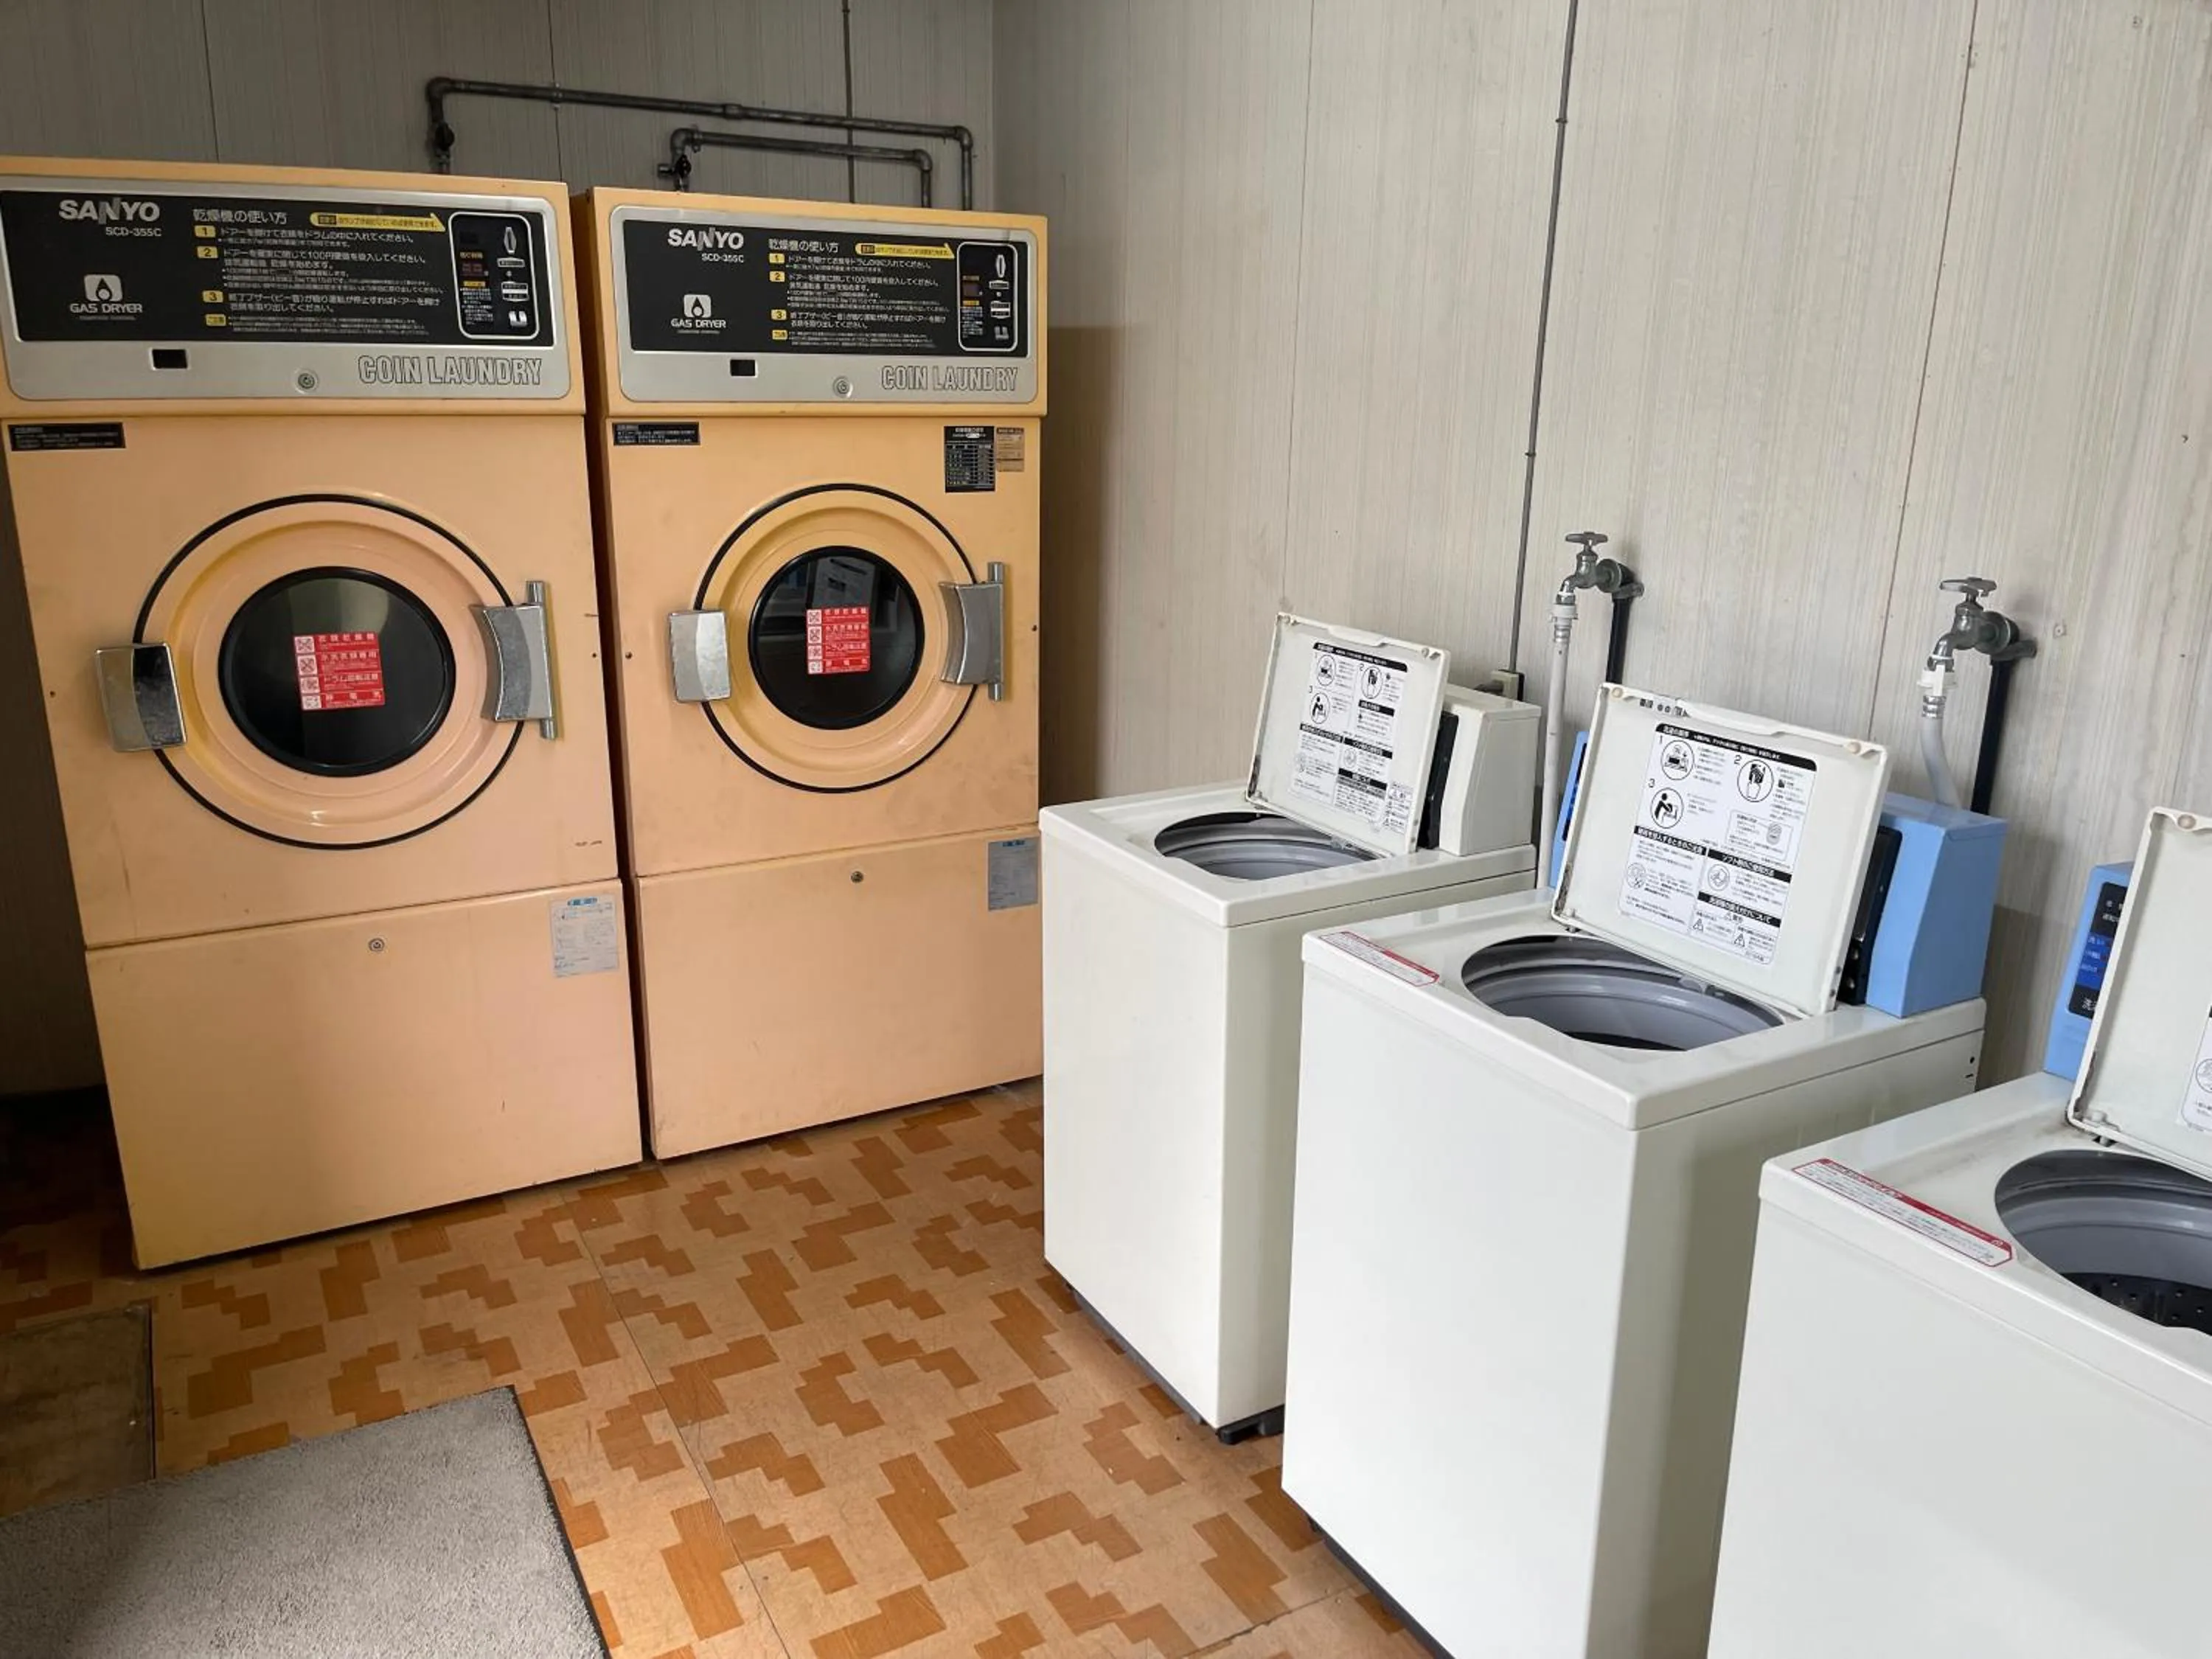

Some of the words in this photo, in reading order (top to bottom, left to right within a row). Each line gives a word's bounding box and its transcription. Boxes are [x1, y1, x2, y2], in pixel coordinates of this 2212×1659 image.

[59, 197, 160, 224] SANYO
[667, 226, 745, 251] SANYO
[70, 303, 98, 313] GAS
[102, 304, 142, 313] DRYER
[670, 318, 692, 327] GAS
[695, 319, 726, 328] DRYER
[358, 355, 423, 384] COIN
[427, 356, 543, 386] LAUNDRY
[881, 365, 928, 390] COIN
[932, 366, 1018, 392] LAUNDRY
[1733, 755, 1742, 765] 2
[1648, 779, 1655, 788] 3
